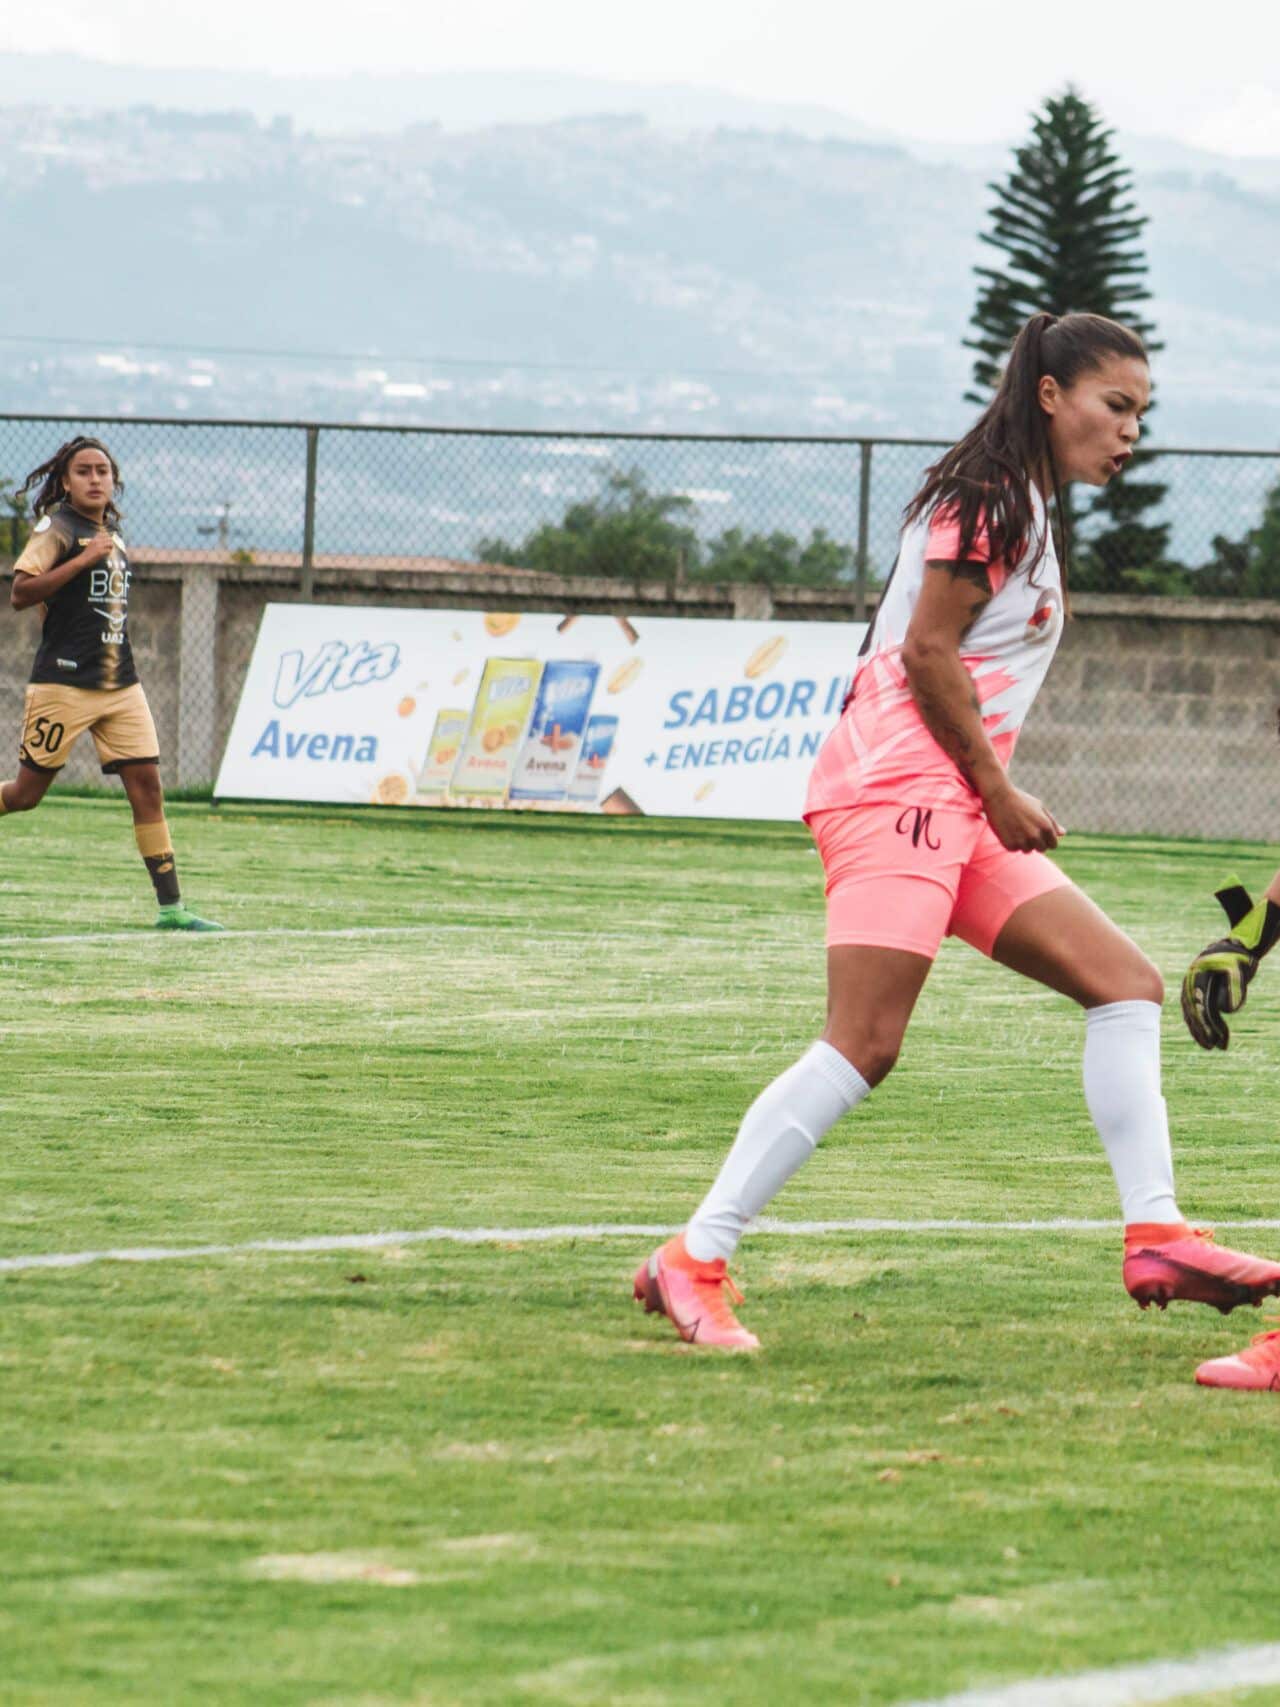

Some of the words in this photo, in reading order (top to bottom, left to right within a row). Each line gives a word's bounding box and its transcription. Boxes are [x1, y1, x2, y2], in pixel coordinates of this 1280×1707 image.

[273, 640, 400, 709] Vita
[663, 679, 816, 729] SABOR
[30, 716, 64, 753] 50
[250, 719, 378, 762] Avena
[664, 728, 790, 771] ENERGÍA
[526, 755, 567, 772] Avena
